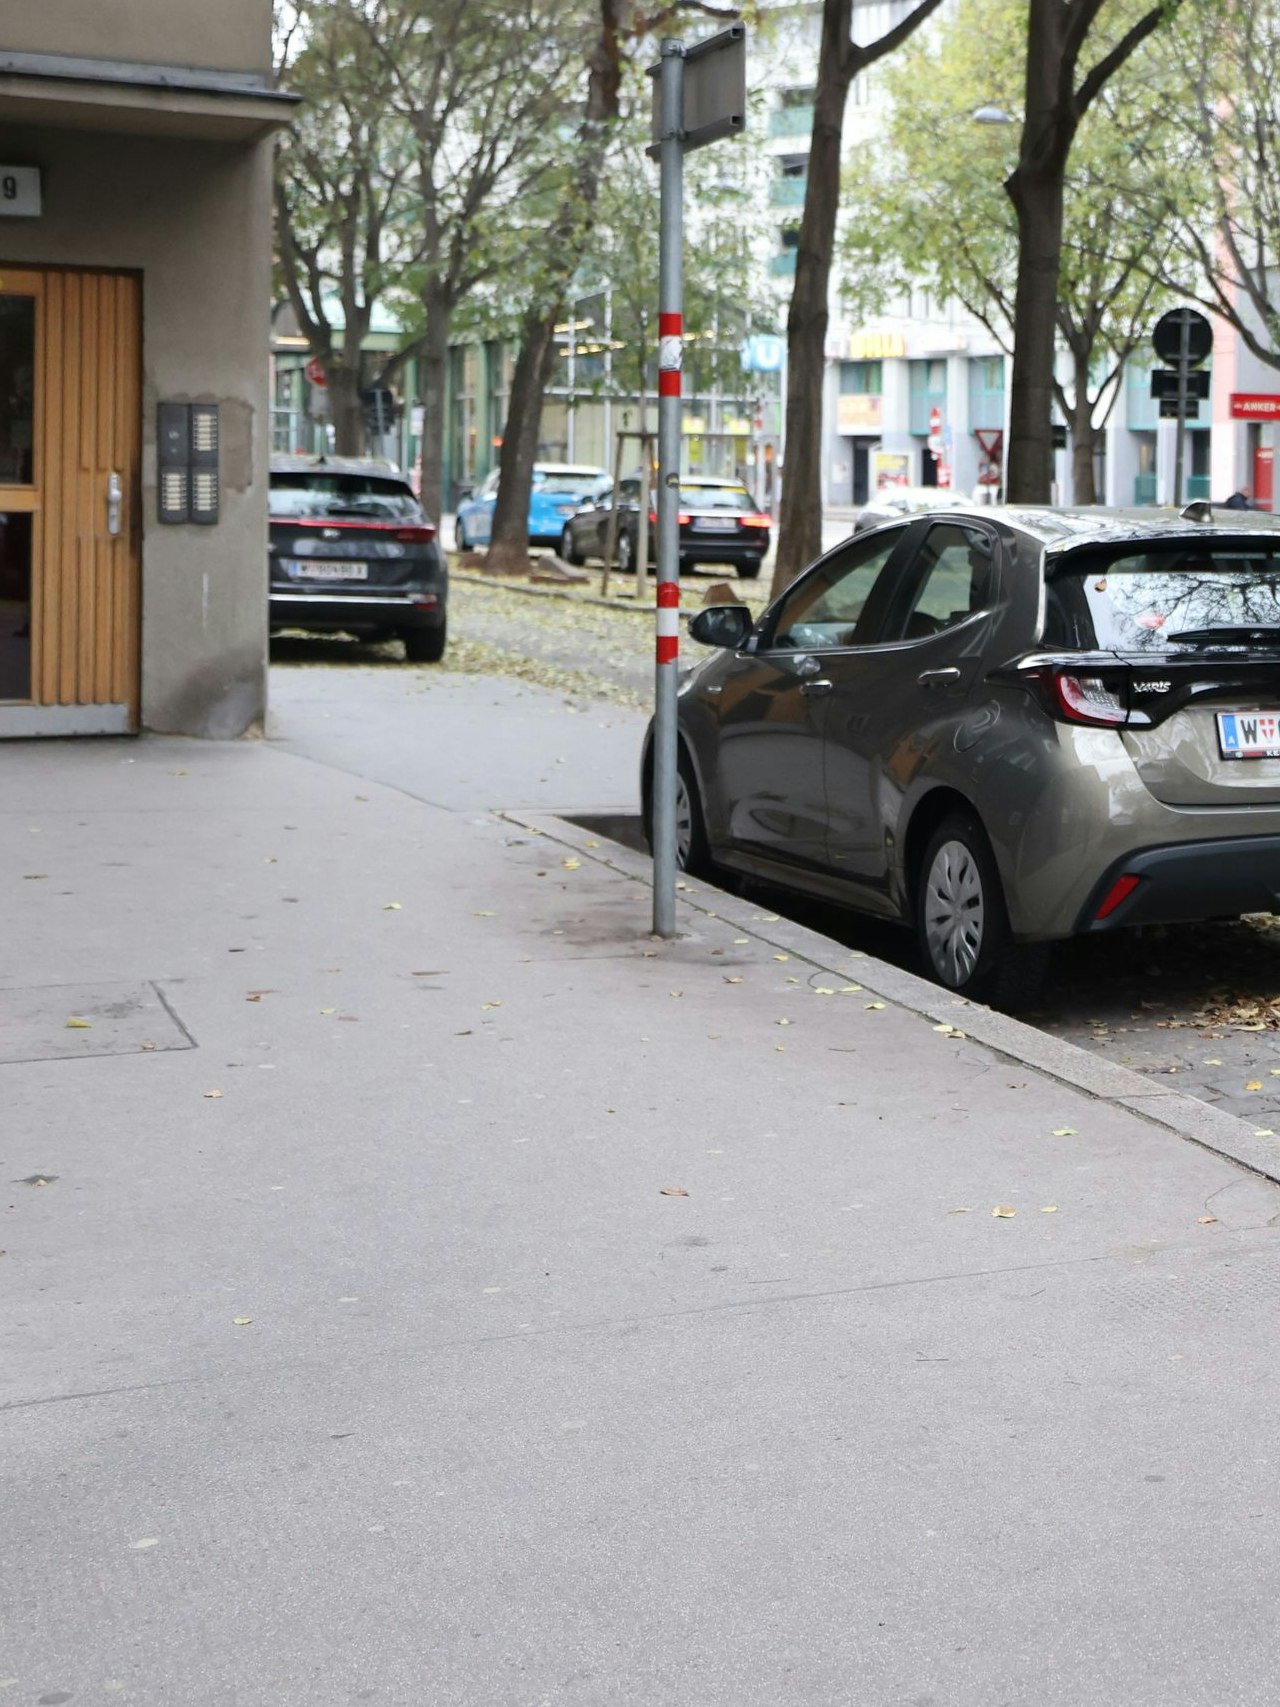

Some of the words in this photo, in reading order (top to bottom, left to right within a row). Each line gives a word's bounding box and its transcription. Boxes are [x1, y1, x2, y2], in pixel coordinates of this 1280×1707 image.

[3, 176, 17, 200] 9
[756, 340, 781, 367] U
[1243, 402, 1276, 412] ANKER
[1133, 681, 1171, 693] YARIS
